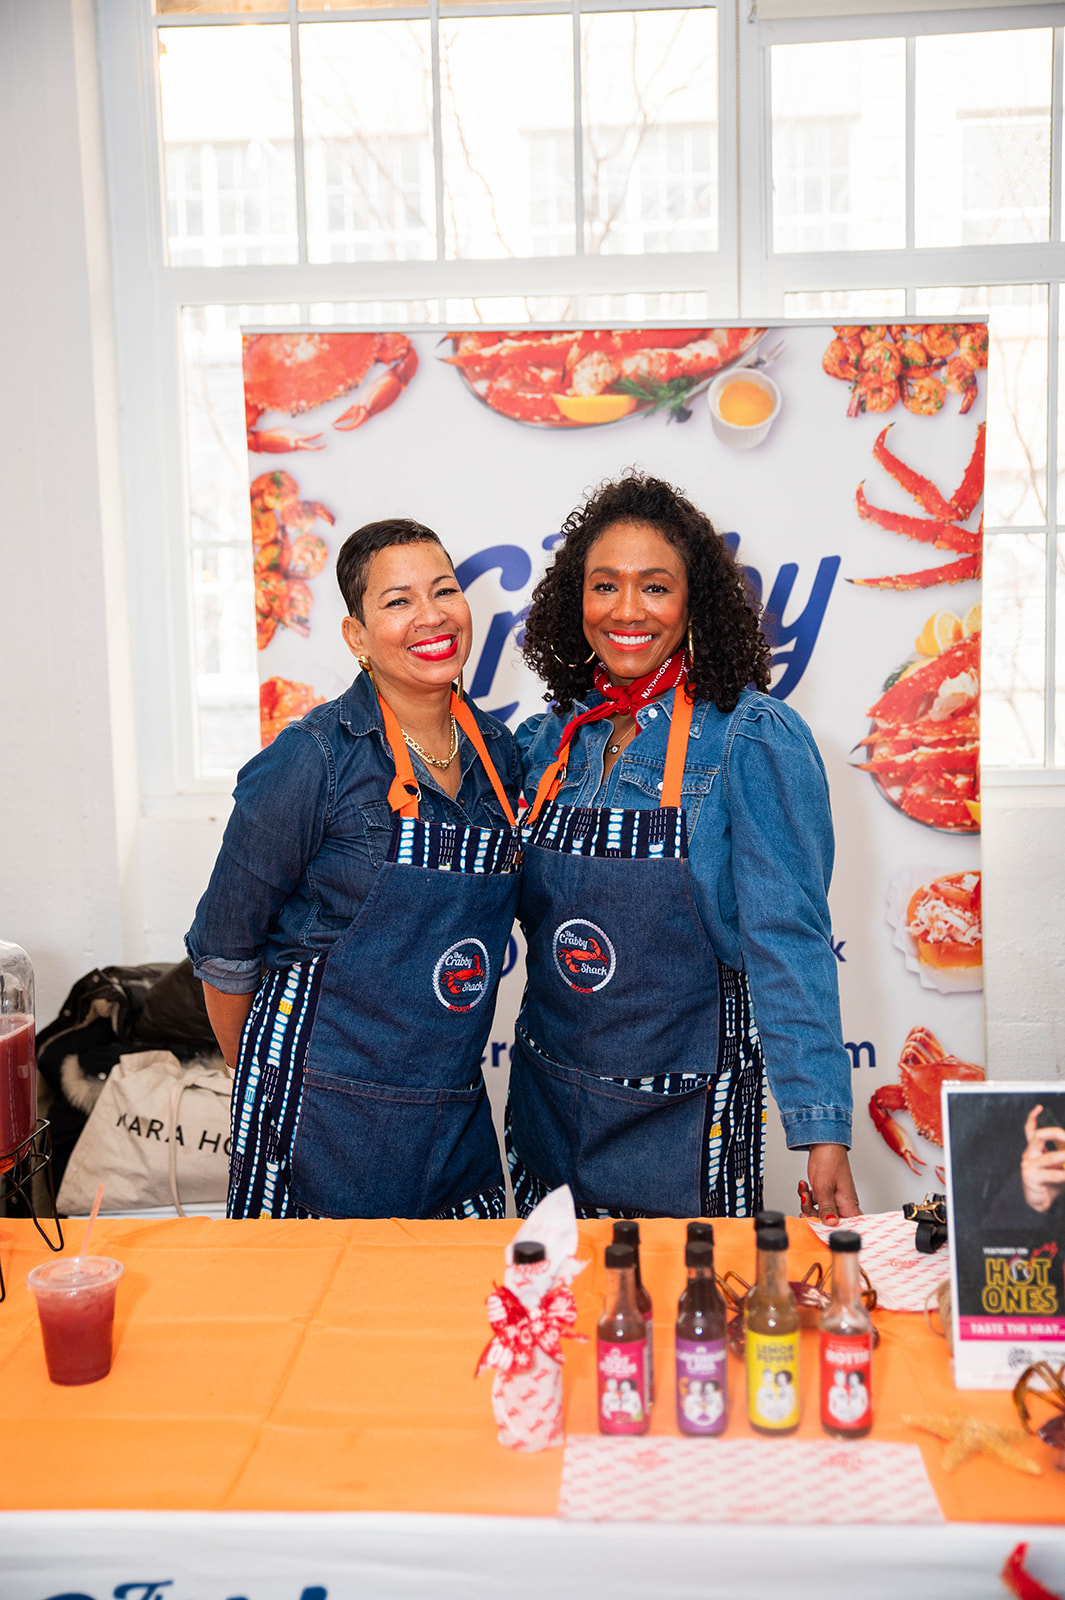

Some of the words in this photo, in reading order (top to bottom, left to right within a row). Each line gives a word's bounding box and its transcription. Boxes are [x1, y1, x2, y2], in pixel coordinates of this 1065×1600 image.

[559, 933, 588, 950] Crabby
[445, 955, 473, 969] Crabby
[580, 962, 608, 976] Shack
[462, 981, 484, 992] Shack
[985, 1258, 1052, 1285] HOT
[982, 1285, 1058, 1314] ONES
[970, 1322, 1004, 1334] TASTE
[1006, 1323, 1028, 1335] THE
